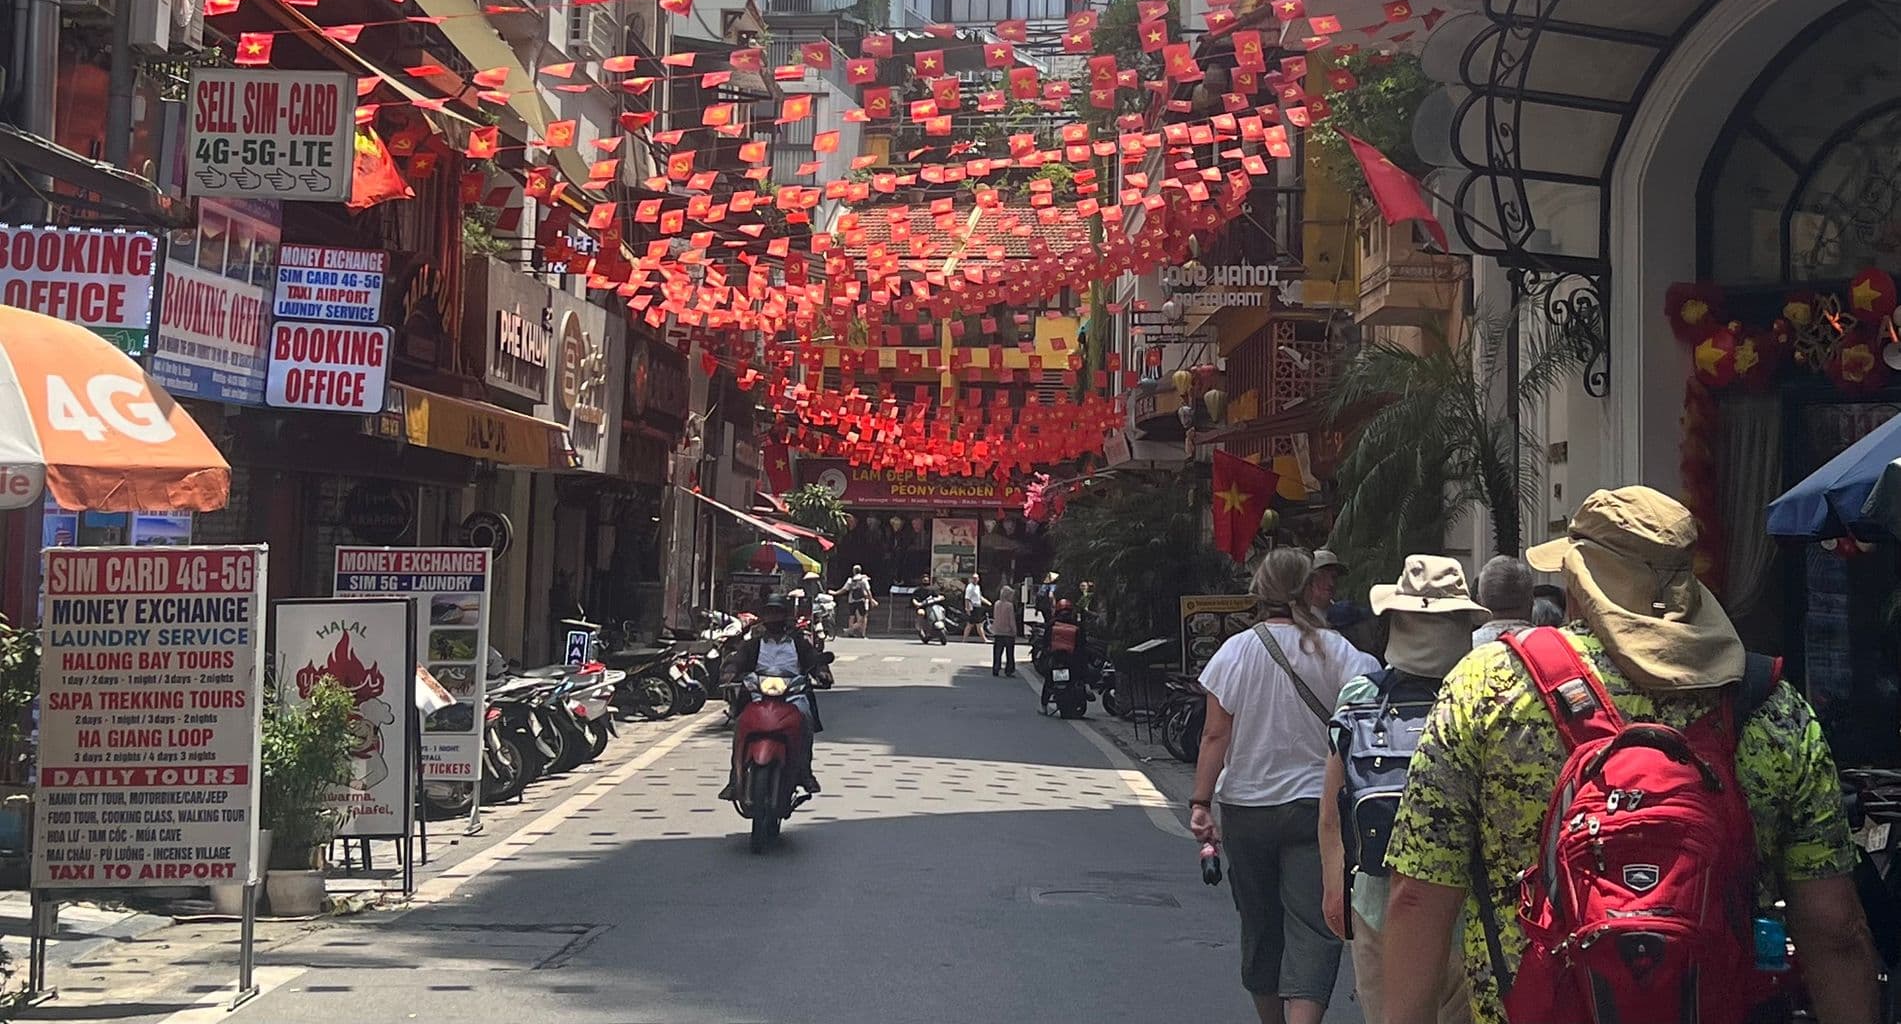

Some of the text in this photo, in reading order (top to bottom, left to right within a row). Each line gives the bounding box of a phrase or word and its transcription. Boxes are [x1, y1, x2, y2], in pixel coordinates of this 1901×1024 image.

[195, 80, 338, 136] SELL SIM-CARD
[195, 138, 333, 168] 4G-5G-LTE
[281, 246, 385, 272] MONEY EXCHANGE
[279, 268, 381, 289] SIM CARD 4G-5G
[4, 279, 126, 323] OFFICE
[287, 285, 371, 304] TAXI AIRPORT
[162, 271, 227, 340] BOOKING
[278, 302, 375, 321] LAUNDY SERVICE
[275, 326, 385, 368] BOOKING
[285, 367, 366, 407] OFFICE
[46, 374, 177, 443] 4G
[940, 486, 994, 497] GARDEN
[341, 552, 482, 572] MONEY EXCHANGE
[52, 555, 252, 593] SIM CARD 4G-5G
[350, 576, 377, 591] SIM
[380, 576, 398, 591] 5G
[412, 576, 473, 591] LAUNDRY
[52, 597, 248, 625] MONEY EXCHANGE
[51, 628, 248, 647] LAUNDRY SERVICE
[316, 619, 369, 640] HALAL
[62, 651, 234, 670] HALONG BAY TOURS
[49, 689, 246, 711] SAPA TREKKING TOURS
[78, 728, 213, 748] HA GIANG LOOP
[74, 752, 80, 762] 3
[82, 752, 102, 763] days
[105, 752, 111, 761] 2
[113, 751, 140, 763] nights
[149, 751, 155, 761] 4
[157, 751, 178, 762] days
[180, 751, 186, 761] 3
[188, 750, 216, 761] nights
[53, 768, 236, 786] DAILY TOURS
[430, 763, 471, 775] TICKETS
[49, 792, 77, 805] HANOI
[79, 792, 98, 805] CITY
[48, 810, 71, 824] FOOD
[101, 810, 142, 824] COOKING
[144, 809, 175, 824] CLASS,
[178, 809, 219, 823] WALKING
[221, 808, 245, 822] TOUR
[47, 829, 65, 843] HOA
[88, 829, 107, 843] TAM
[159, 828, 182, 842] CAVE
[47, 848, 64, 862] MAI
[153, 847, 193, 860] INCENSE
[195, 846, 231, 860] VILLAGE
[50, 862, 237, 880] TAXI TO AIRPORT
